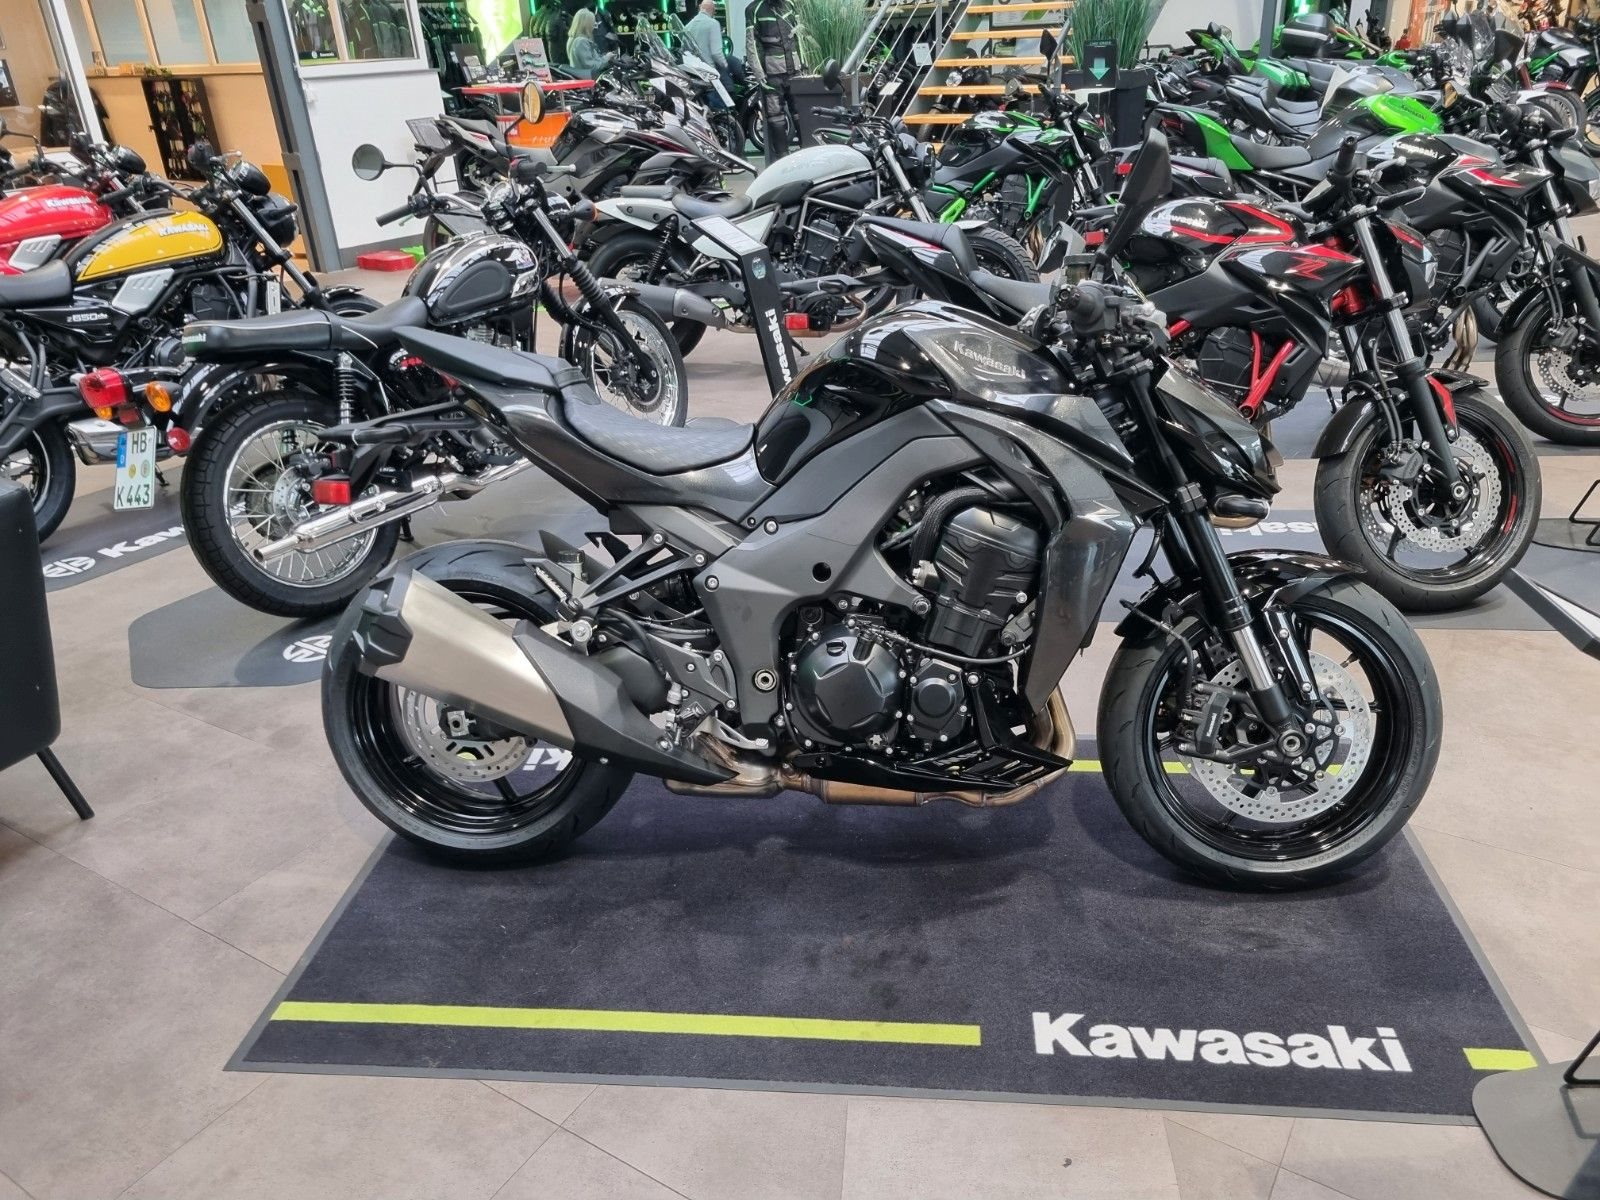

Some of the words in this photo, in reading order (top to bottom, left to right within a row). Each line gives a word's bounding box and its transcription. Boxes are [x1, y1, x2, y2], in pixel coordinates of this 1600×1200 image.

[953, 340, 1026, 379] Kawasaki
[131, 432, 148, 454] HB
[116, 486, 125, 507] K
[126, 483, 150, 506] 443
[1032, 1011, 1413, 1073] Kawasaki
